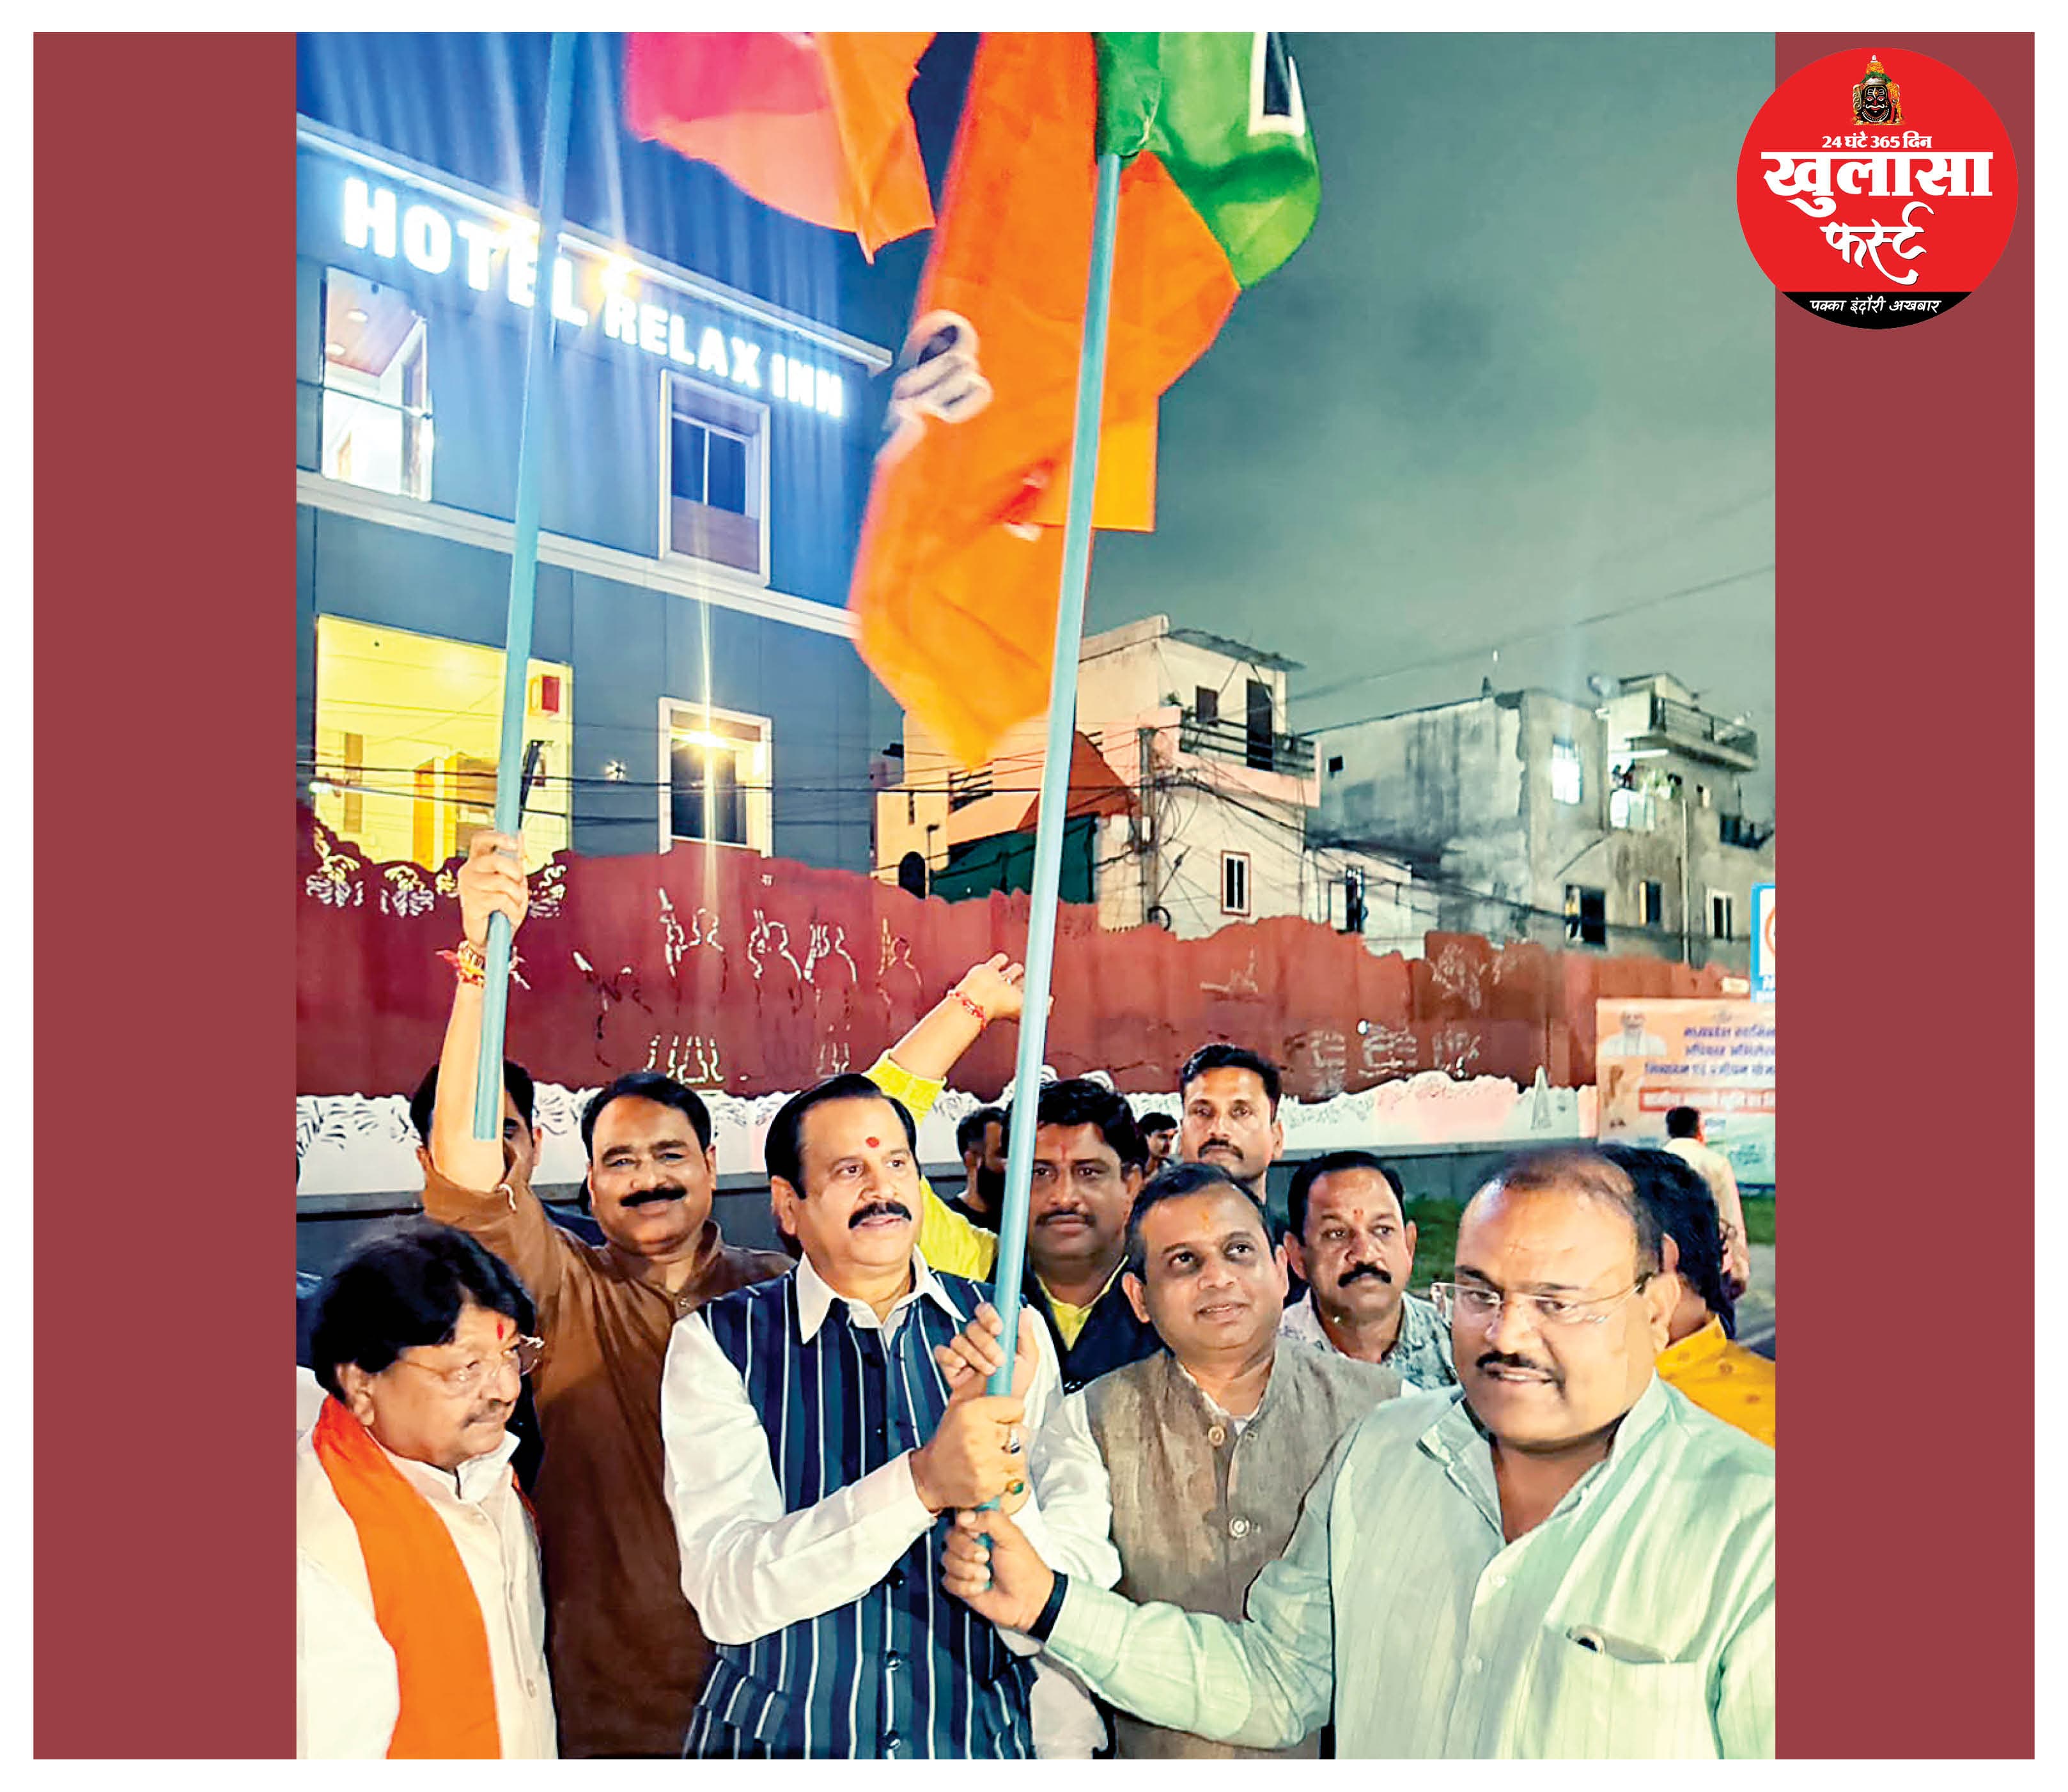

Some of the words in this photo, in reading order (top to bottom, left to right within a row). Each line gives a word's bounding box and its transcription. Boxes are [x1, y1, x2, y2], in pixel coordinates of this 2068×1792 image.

[343, 177, 589, 328] HOTEL
[603, 293, 761, 389] RELAX
[771, 352, 844, 417] INN
